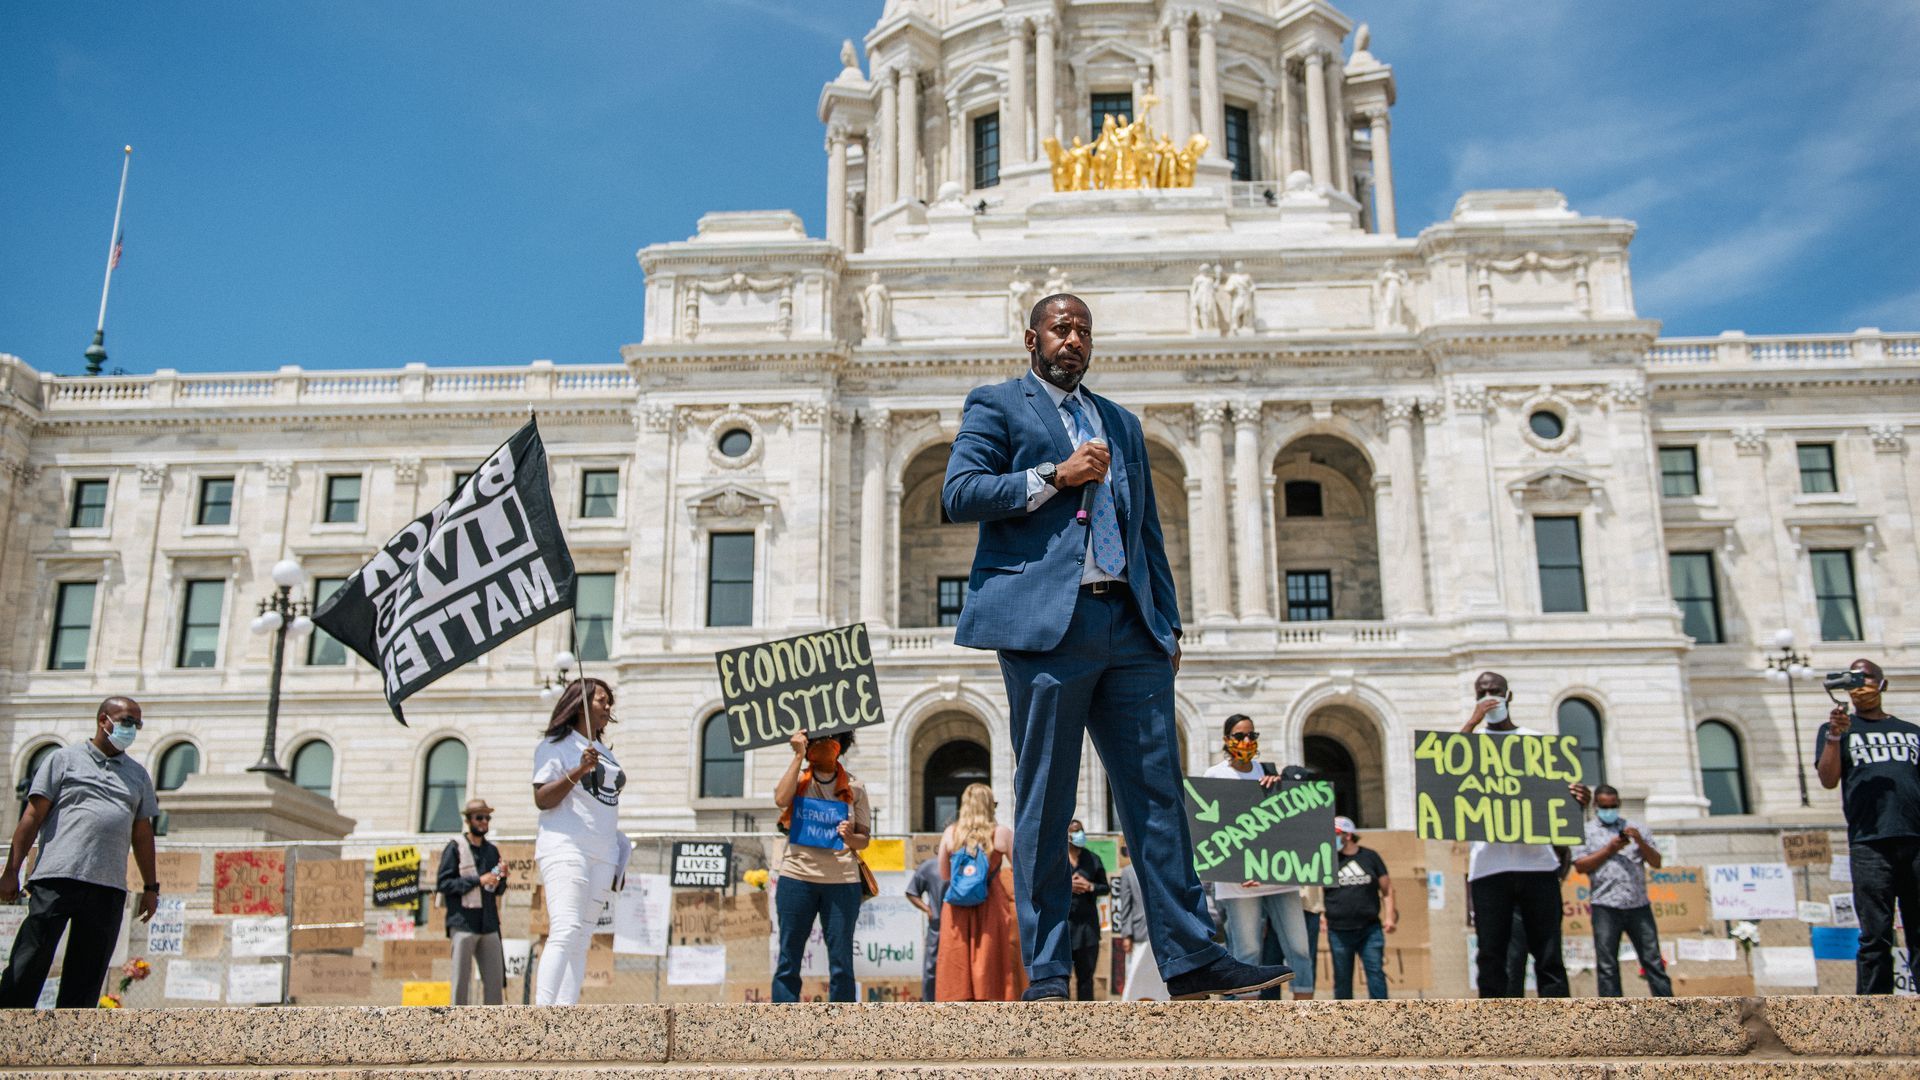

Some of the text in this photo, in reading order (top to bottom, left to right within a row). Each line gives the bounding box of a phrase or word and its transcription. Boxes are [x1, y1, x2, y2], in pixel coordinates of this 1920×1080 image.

[720, 624, 872, 699] ECONOMIC
[728, 674, 880, 746] JUSTICE
[1415, 731, 1583, 784] 40 ACRES
[1457, 774, 1521, 796] AND
[1418, 792, 1582, 845] A MULE
[378, 848, 415, 865] HELP!
[681, 844, 724, 856] BLACK
[682, 858, 720, 869] LIVES
[1244, 842, 1333, 885] NOW!
[674, 873, 726, 886] MATTER
[673, 912, 720, 935] HIDING
[868, 941, 914, 968] Uphold
